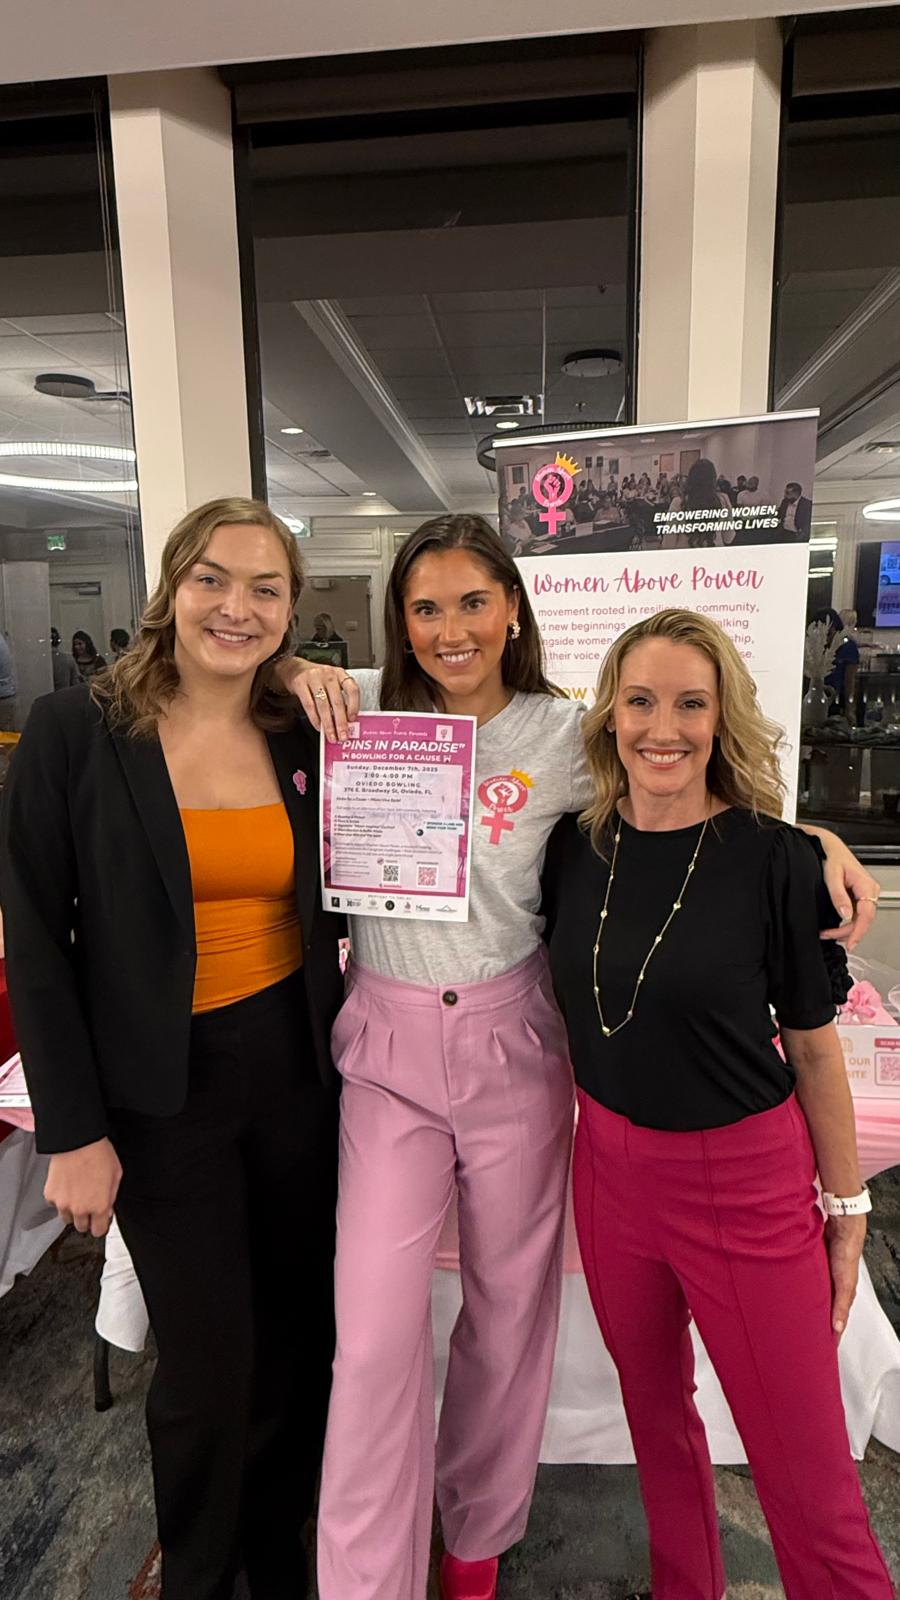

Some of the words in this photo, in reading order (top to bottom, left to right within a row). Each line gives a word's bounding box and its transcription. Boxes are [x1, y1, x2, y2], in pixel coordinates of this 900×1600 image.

[653, 508, 728, 523] EMPOWERING
[731, 505, 778, 518] WOMEN,
[656, 521, 742, 535] TRANSFORMING
[745, 518, 778, 530] LIVES
[534, 573, 609, 595] Women
[614, 567, 682, 593] Above
[691, 566, 764, 591] Power
[538, 607, 589, 616] movement
[592, 606, 625, 615] rooted
[628, 605, 637, 614] in
[696, 602, 759, 613] community,
[571, 622, 626, 632] beginnings
[543, 637, 574, 647] ngside
[549, 652, 571, 660] their
[573, 652, 602, 661] voice,
[374, 740, 388, 751] IN
[391, 740, 465, 753] PARADISE"
[351, 752, 387, 760] BOWLING
[388, 753, 404, 761] FOR
[414, 754, 441, 762] CAUSE
[848, 1057, 871, 1066] OUR
